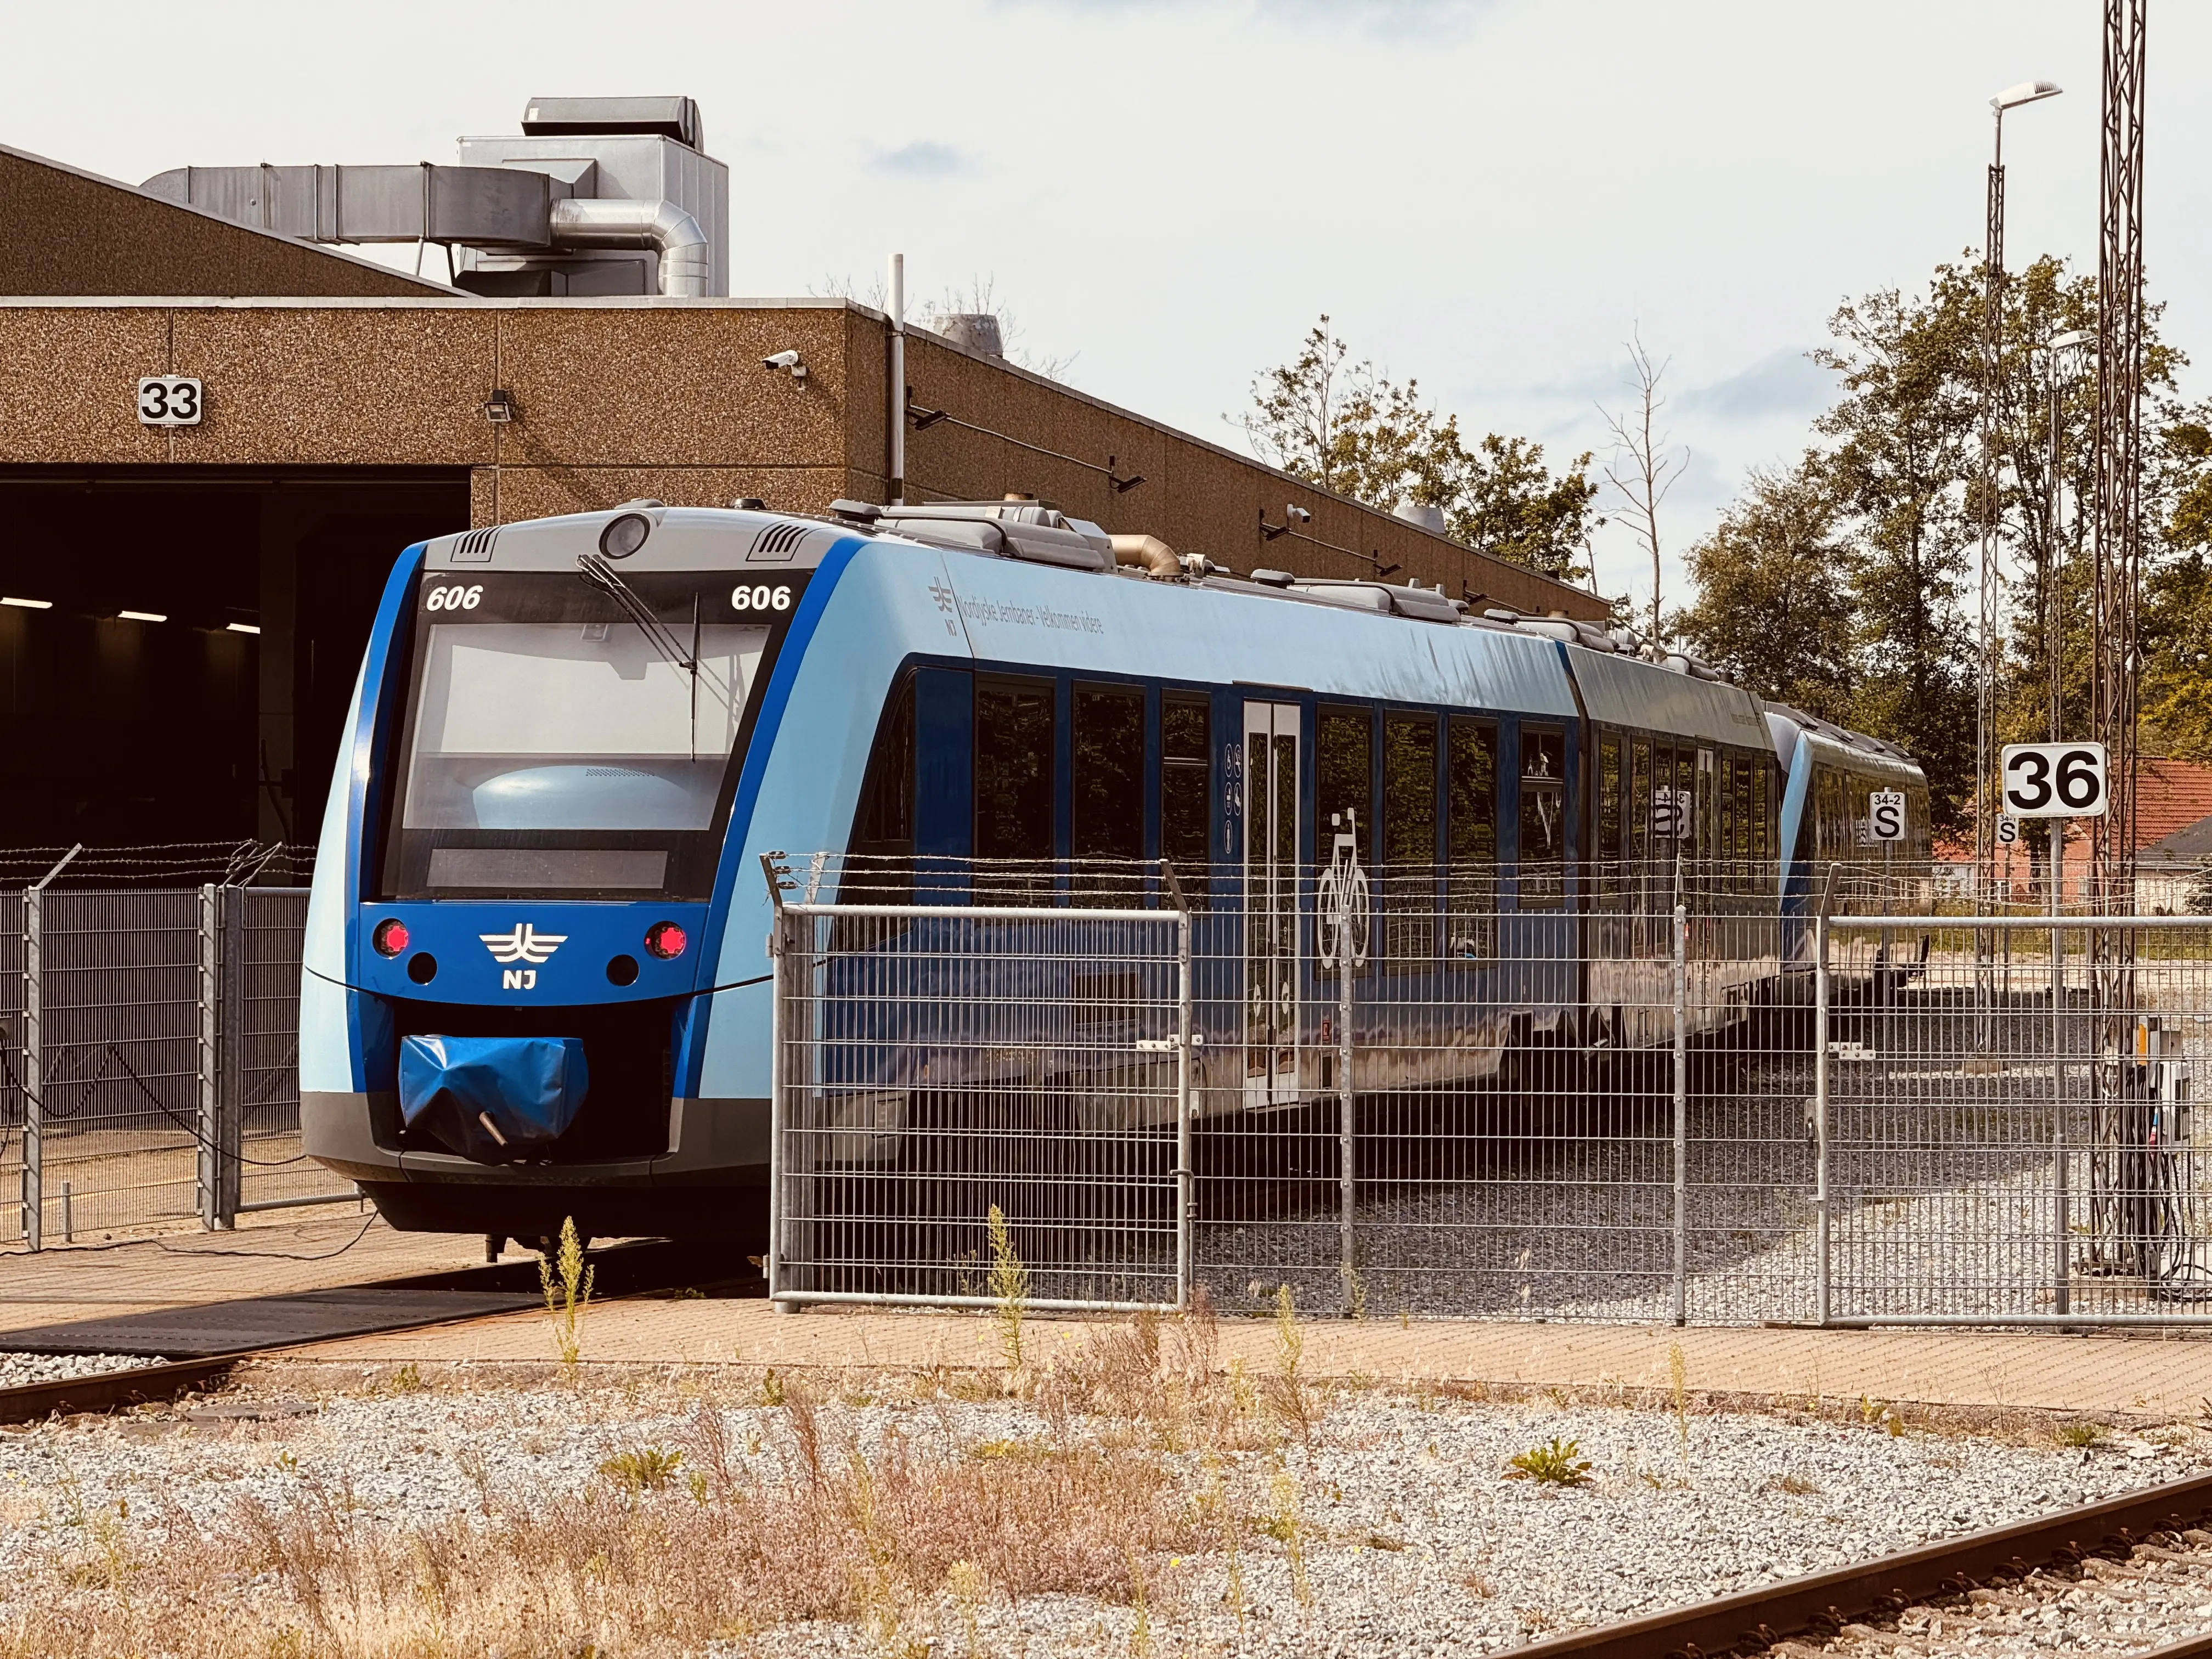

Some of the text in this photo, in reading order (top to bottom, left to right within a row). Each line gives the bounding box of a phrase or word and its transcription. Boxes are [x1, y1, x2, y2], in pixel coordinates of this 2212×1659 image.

[142, 382, 198, 419] 33
[427, 585, 483, 611] 606
[732, 585, 791, 611] 606
[956, 595, 998, 627] Nordjyske
[996, 600, 1036, 625] Jernbaner
[1036, 605, 1082, 631] Velkommen
[1079, 610, 1104, 634] videre
[2007, 751, 2100, 810] 36
[1874, 794, 1900, 805] 34-2
[1874, 806, 1900, 838] S
[1999, 822, 2016, 842] S
[503, 970, 537, 990] NJ
